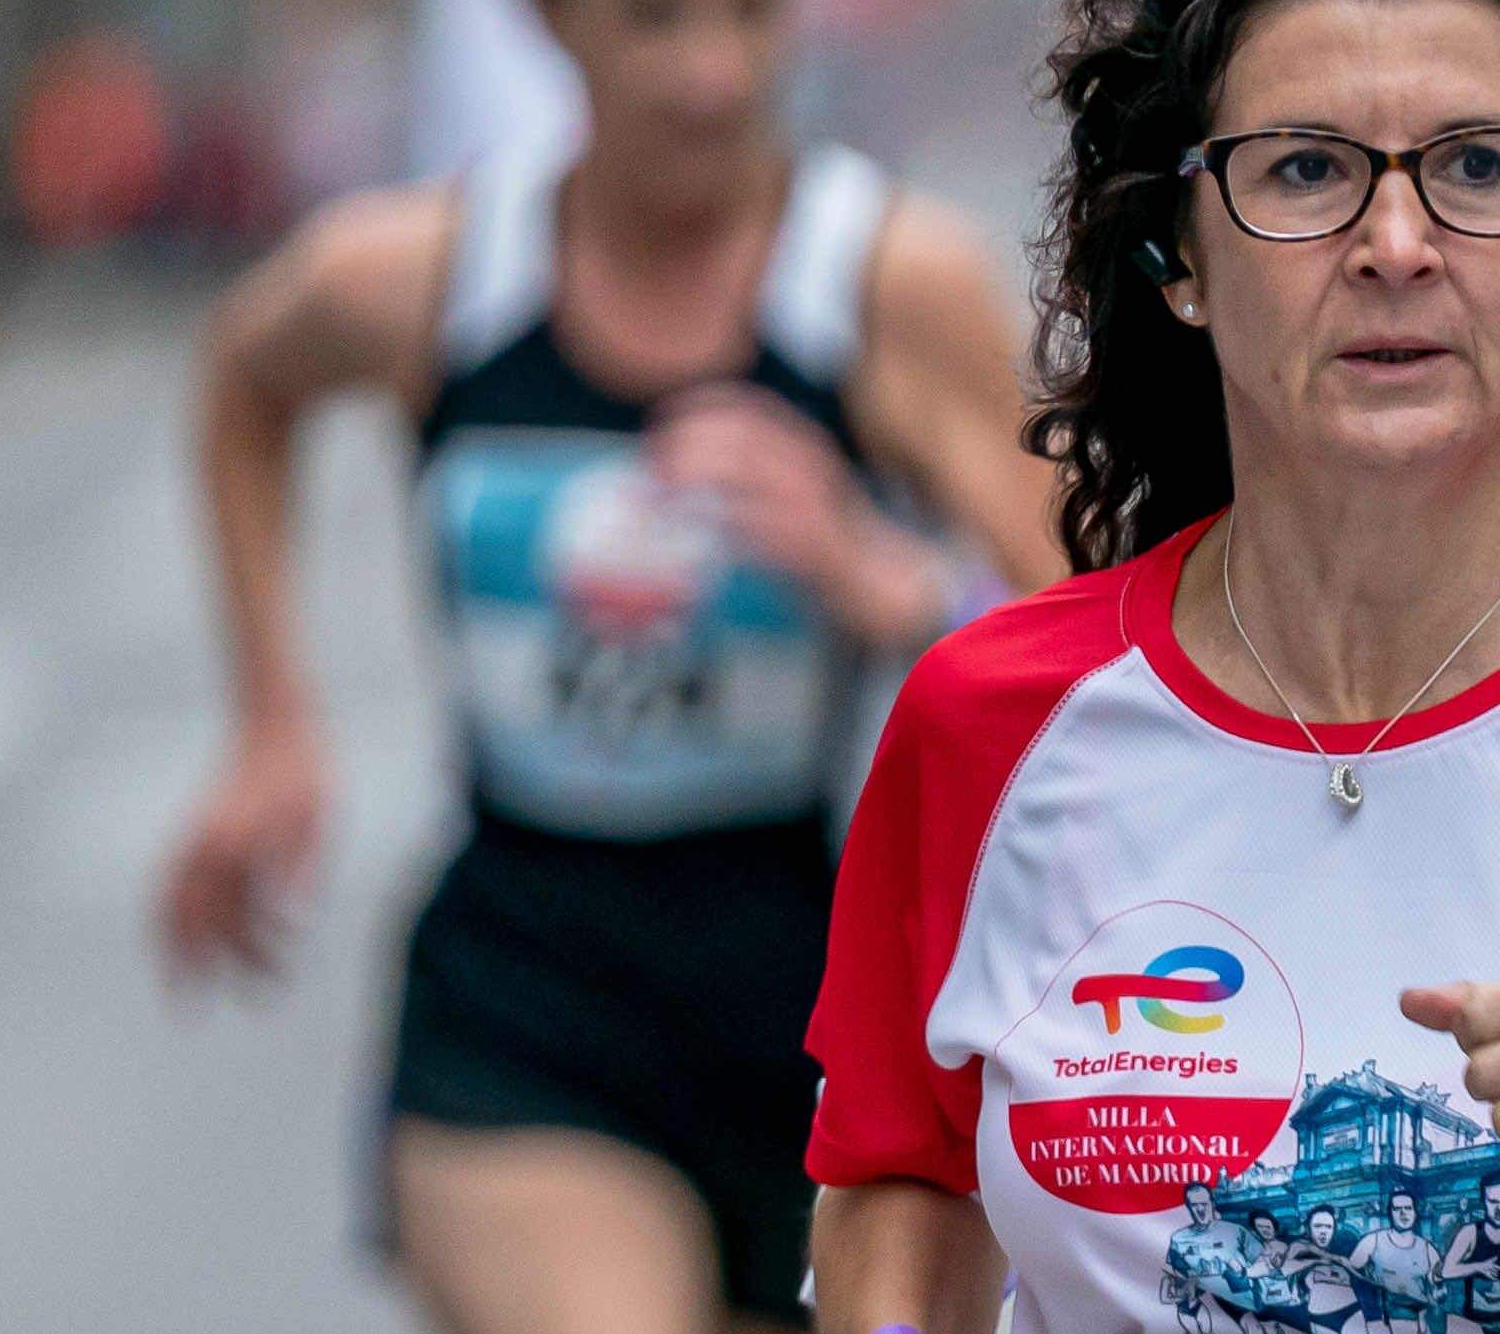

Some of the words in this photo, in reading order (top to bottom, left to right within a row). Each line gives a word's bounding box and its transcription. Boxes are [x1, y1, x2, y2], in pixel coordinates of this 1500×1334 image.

[1053, 1051, 1239, 1079] TotalEnergies
[1087, 1106, 1177, 1129] MILLA
[1055, 1163, 1092, 1188] DE
[1100, 1162, 1213, 1185] MADRID
